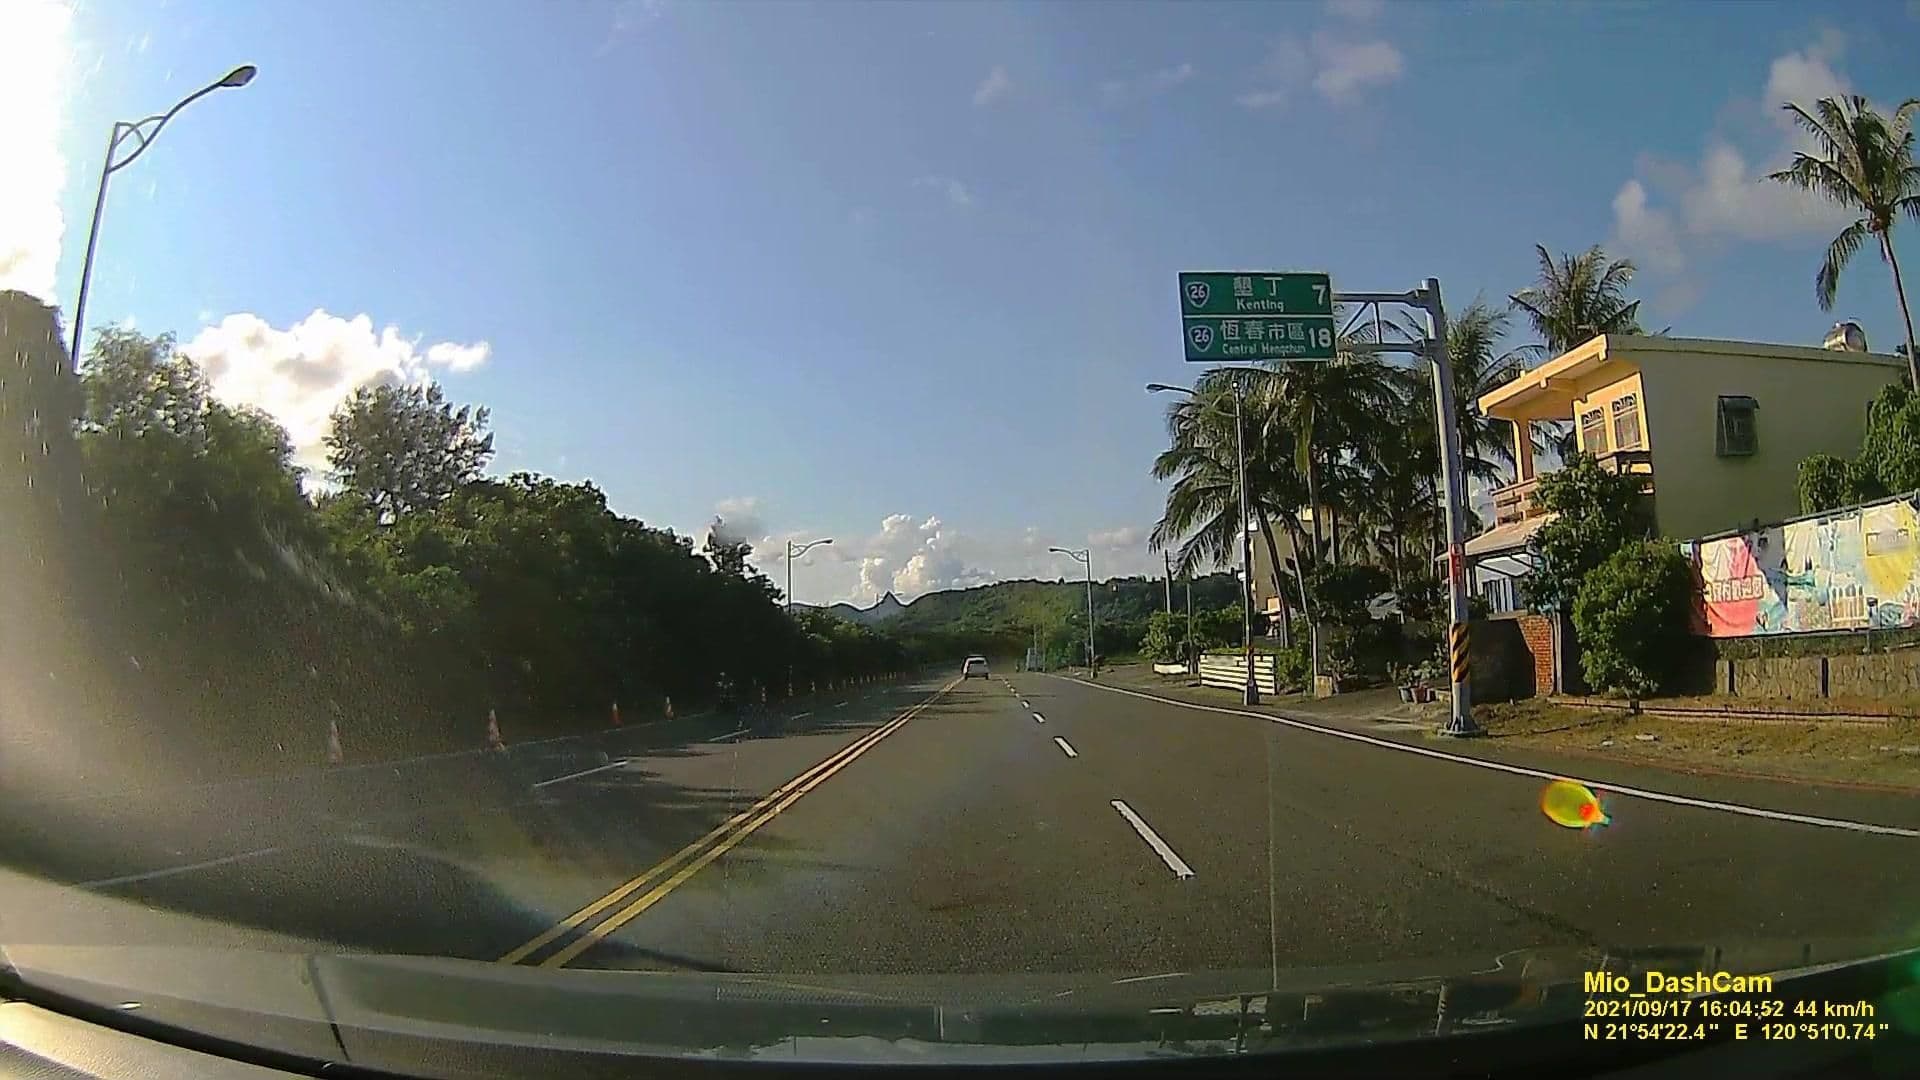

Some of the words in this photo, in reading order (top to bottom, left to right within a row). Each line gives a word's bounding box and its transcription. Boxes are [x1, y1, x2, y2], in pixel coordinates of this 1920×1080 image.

[1190, 285, 1206, 299] 26
[1233, 276, 1283, 297] 墾丁
[1311, 284, 1328, 306] 7
[1236, 298, 1285, 313] Kenting
[1194, 329, 1210, 343] 26
[1309, 327, 1332, 349] 18
[1222, 343, 1257, 355] Central
[1261, 343, 1306, 357] Hengchun
